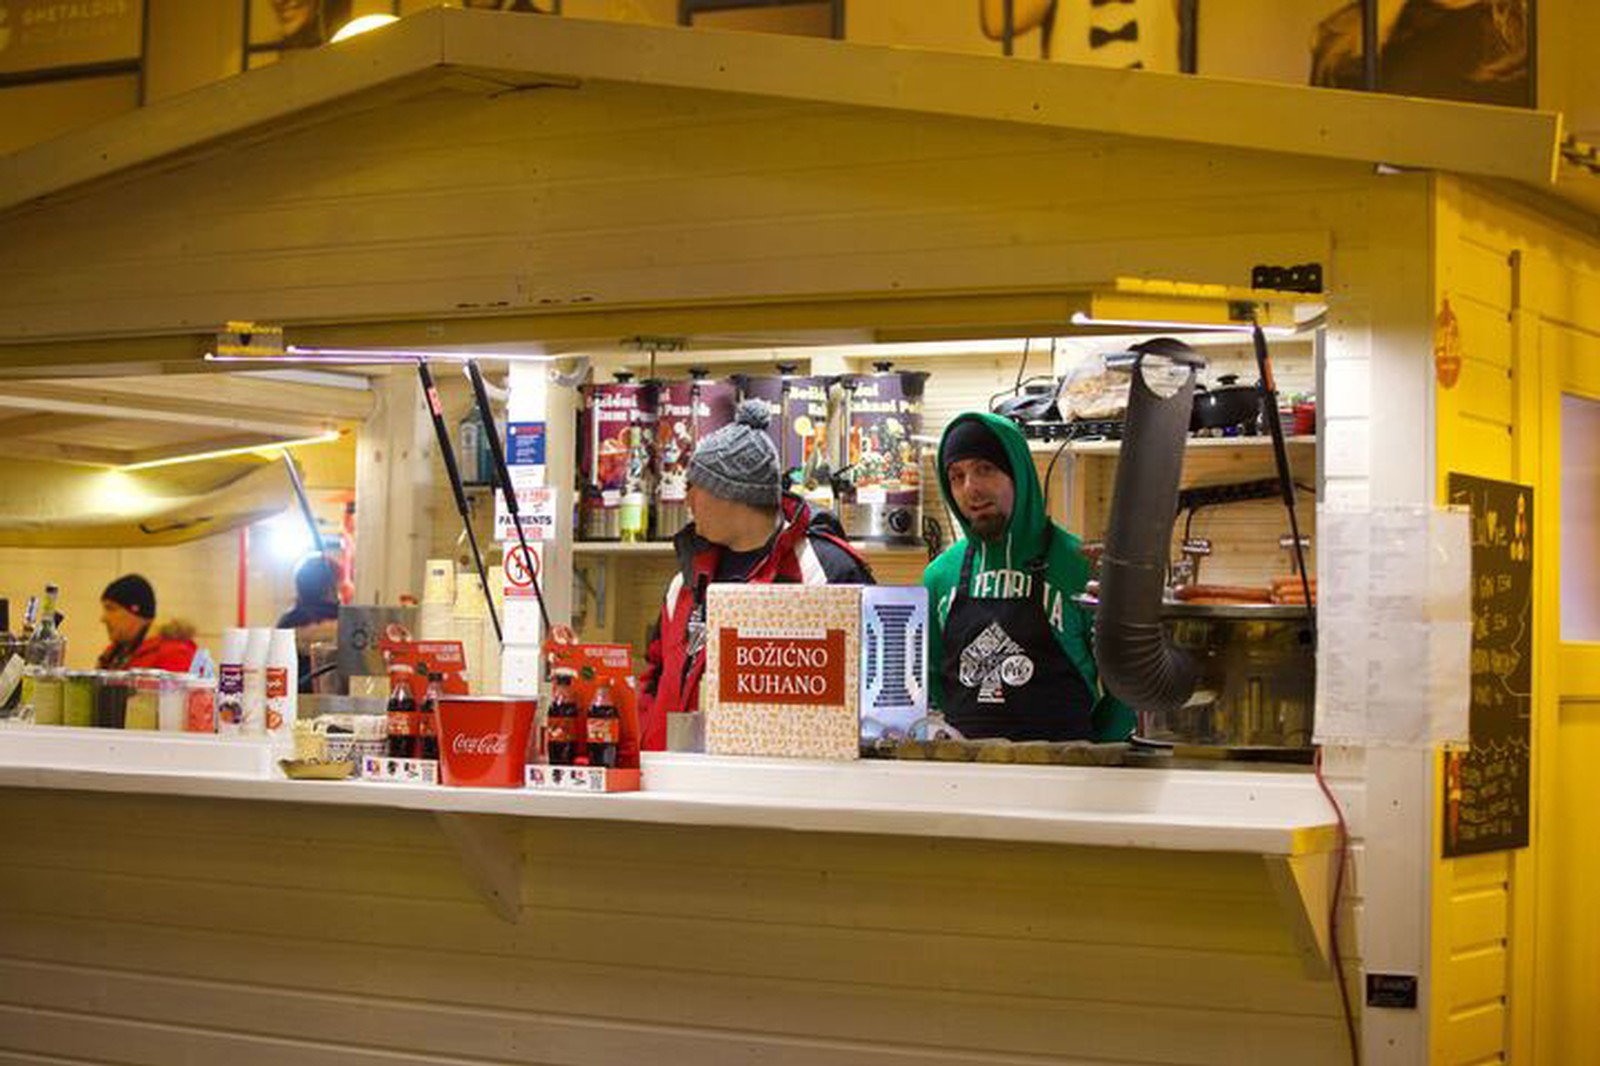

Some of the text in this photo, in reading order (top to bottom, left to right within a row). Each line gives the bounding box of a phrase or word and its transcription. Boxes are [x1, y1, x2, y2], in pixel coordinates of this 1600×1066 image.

[498, 515, 552, 525] PAMENTS
[736, 641, 828, 668] BOŽIĆNO
[737, 674, 827, 694] KUHANO
[452, 732, 509, 756] Coca-Cola
